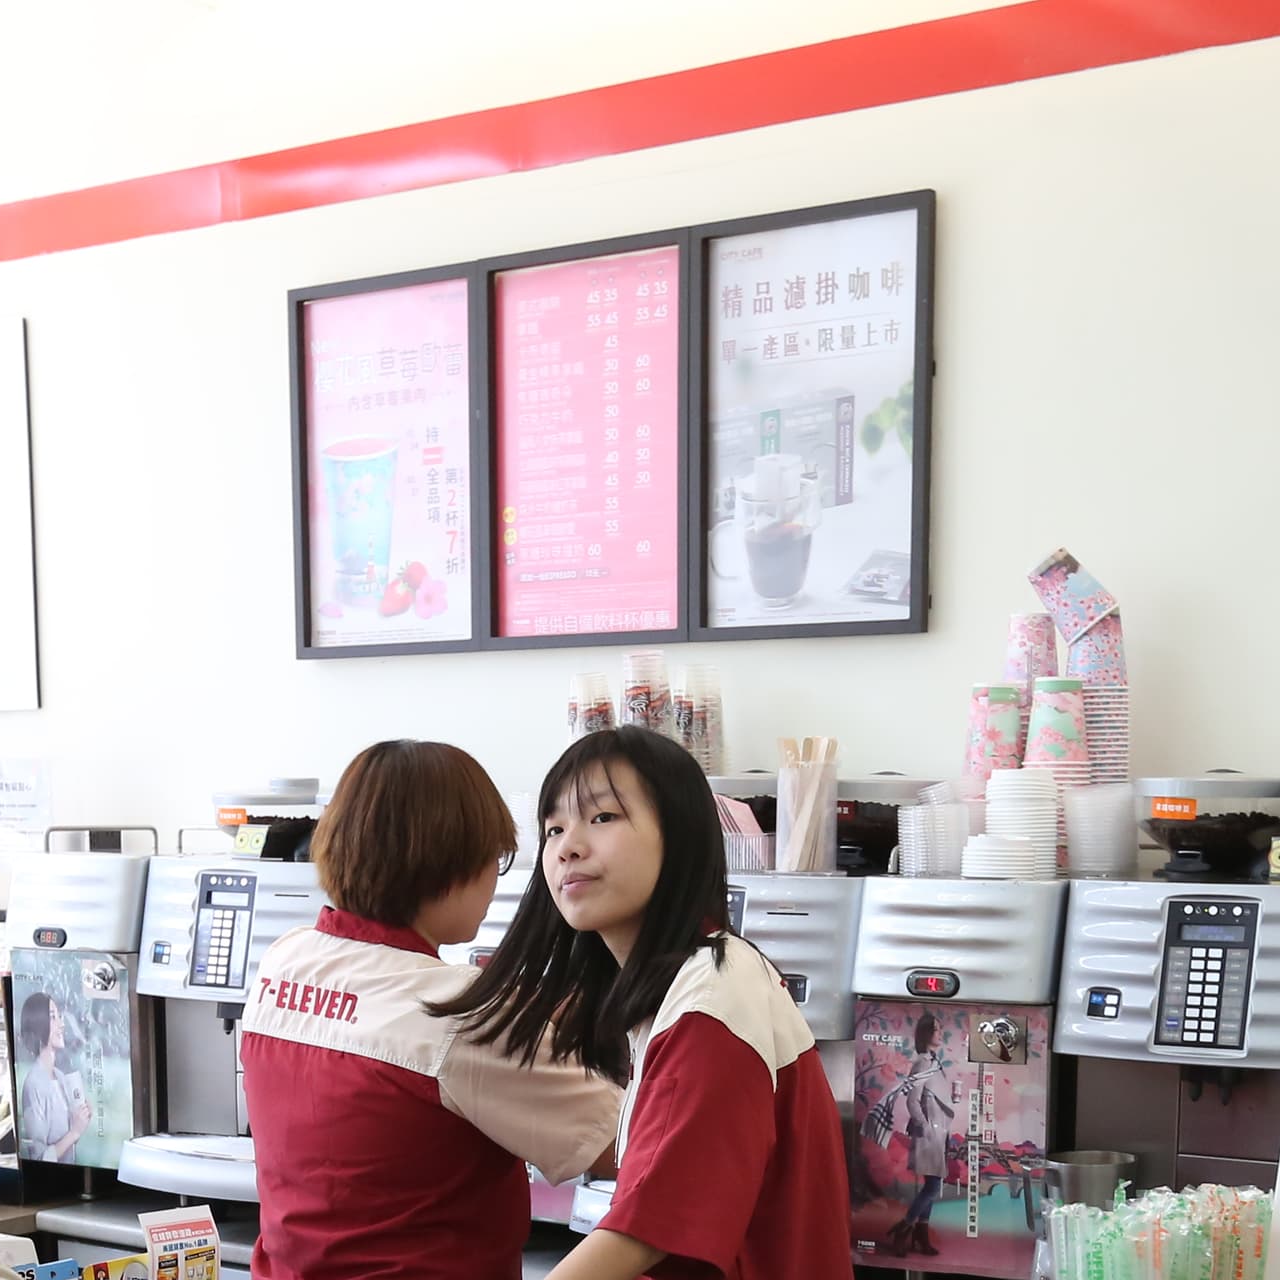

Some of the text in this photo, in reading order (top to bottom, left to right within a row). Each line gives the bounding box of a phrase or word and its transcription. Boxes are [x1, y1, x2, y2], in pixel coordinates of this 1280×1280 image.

[721, 262, 904, 319] 精品濾掛咖啡
